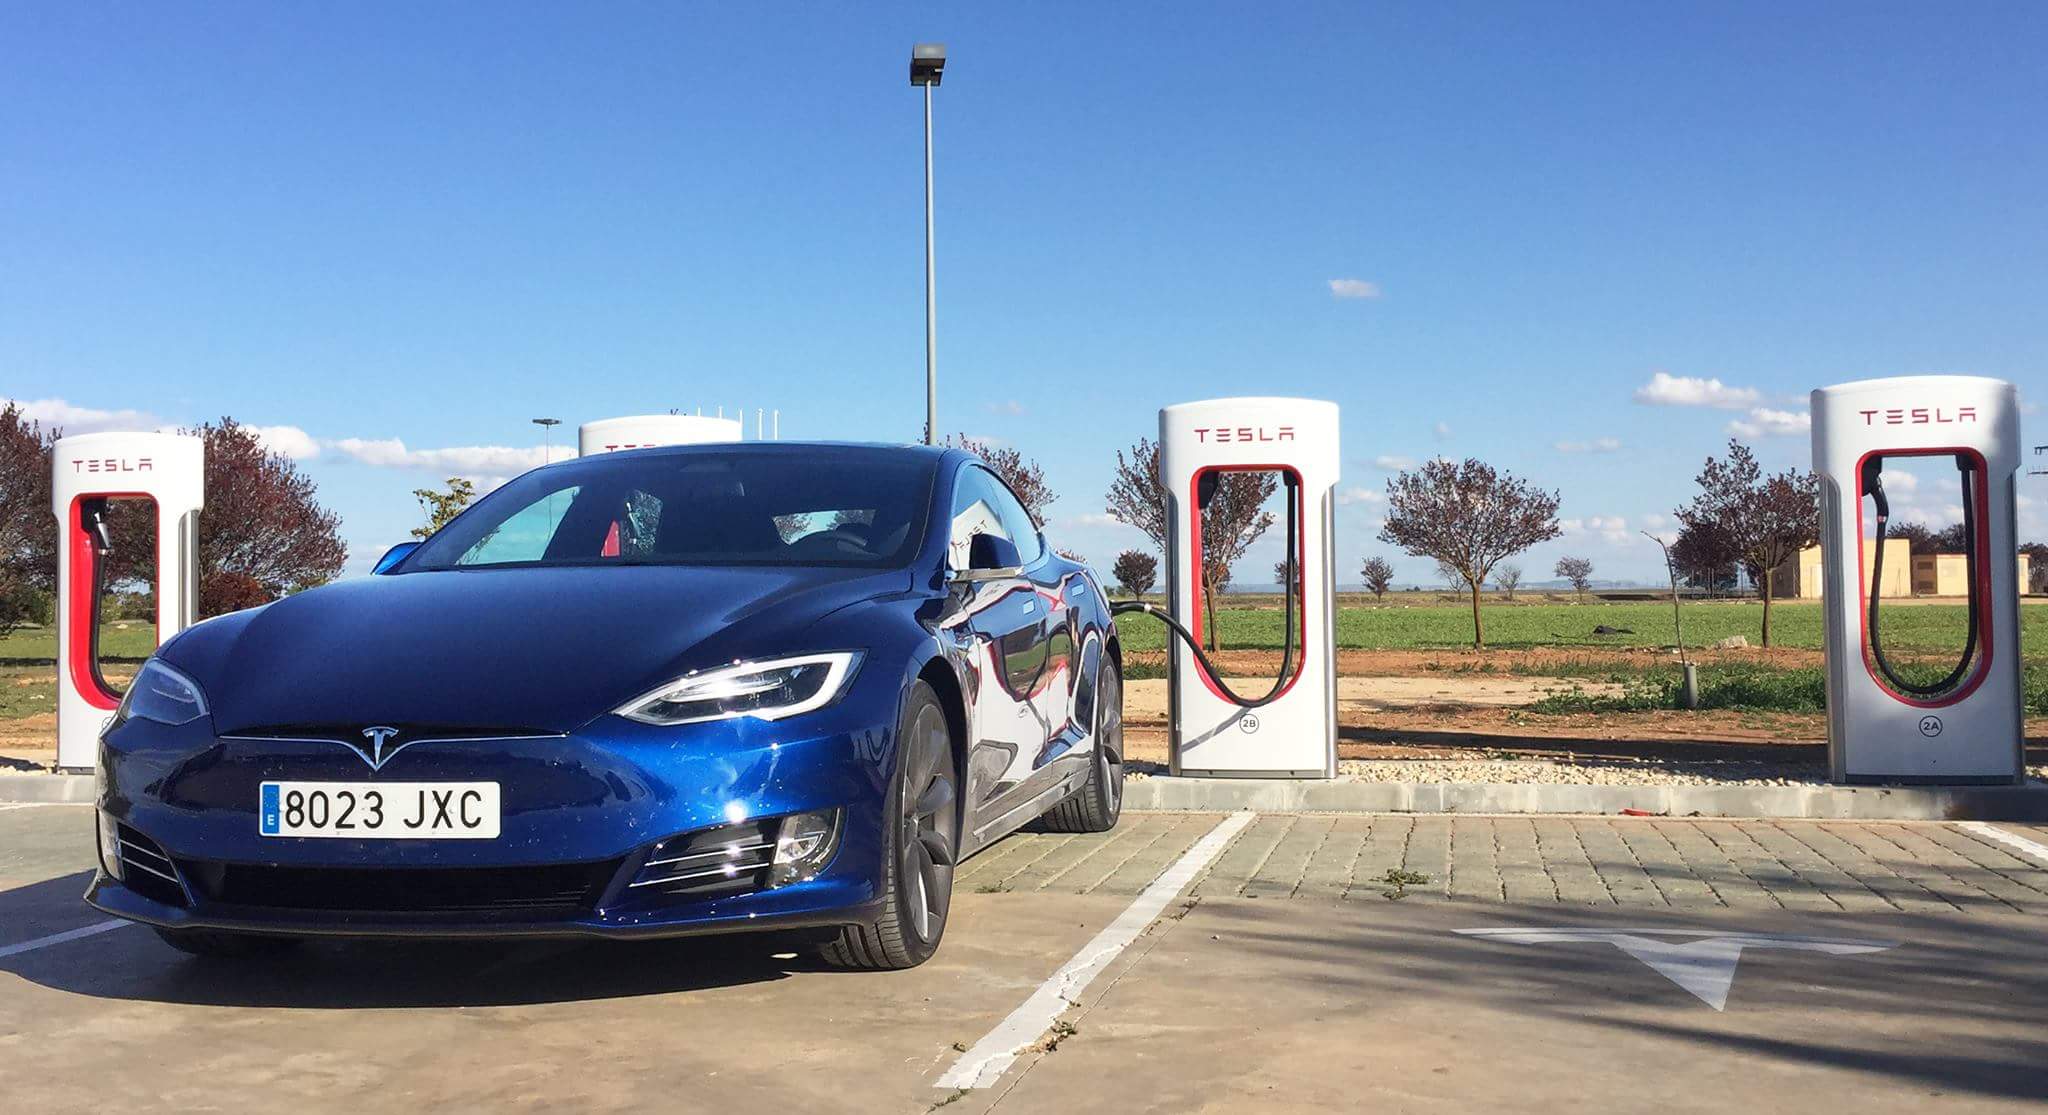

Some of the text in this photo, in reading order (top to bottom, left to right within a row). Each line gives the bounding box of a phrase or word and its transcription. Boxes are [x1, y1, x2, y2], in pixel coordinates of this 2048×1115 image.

[1859, 407, 1976, 425] TESLA
[1194, 426, 1294, 443] TESLA
[72, 458, 152, 473] TESLA
[1242, 719, 1256, 728] 2B
[1923, 721, 1940, 730] 2A
[266, 790, 482, 829] E 8023 JXC
